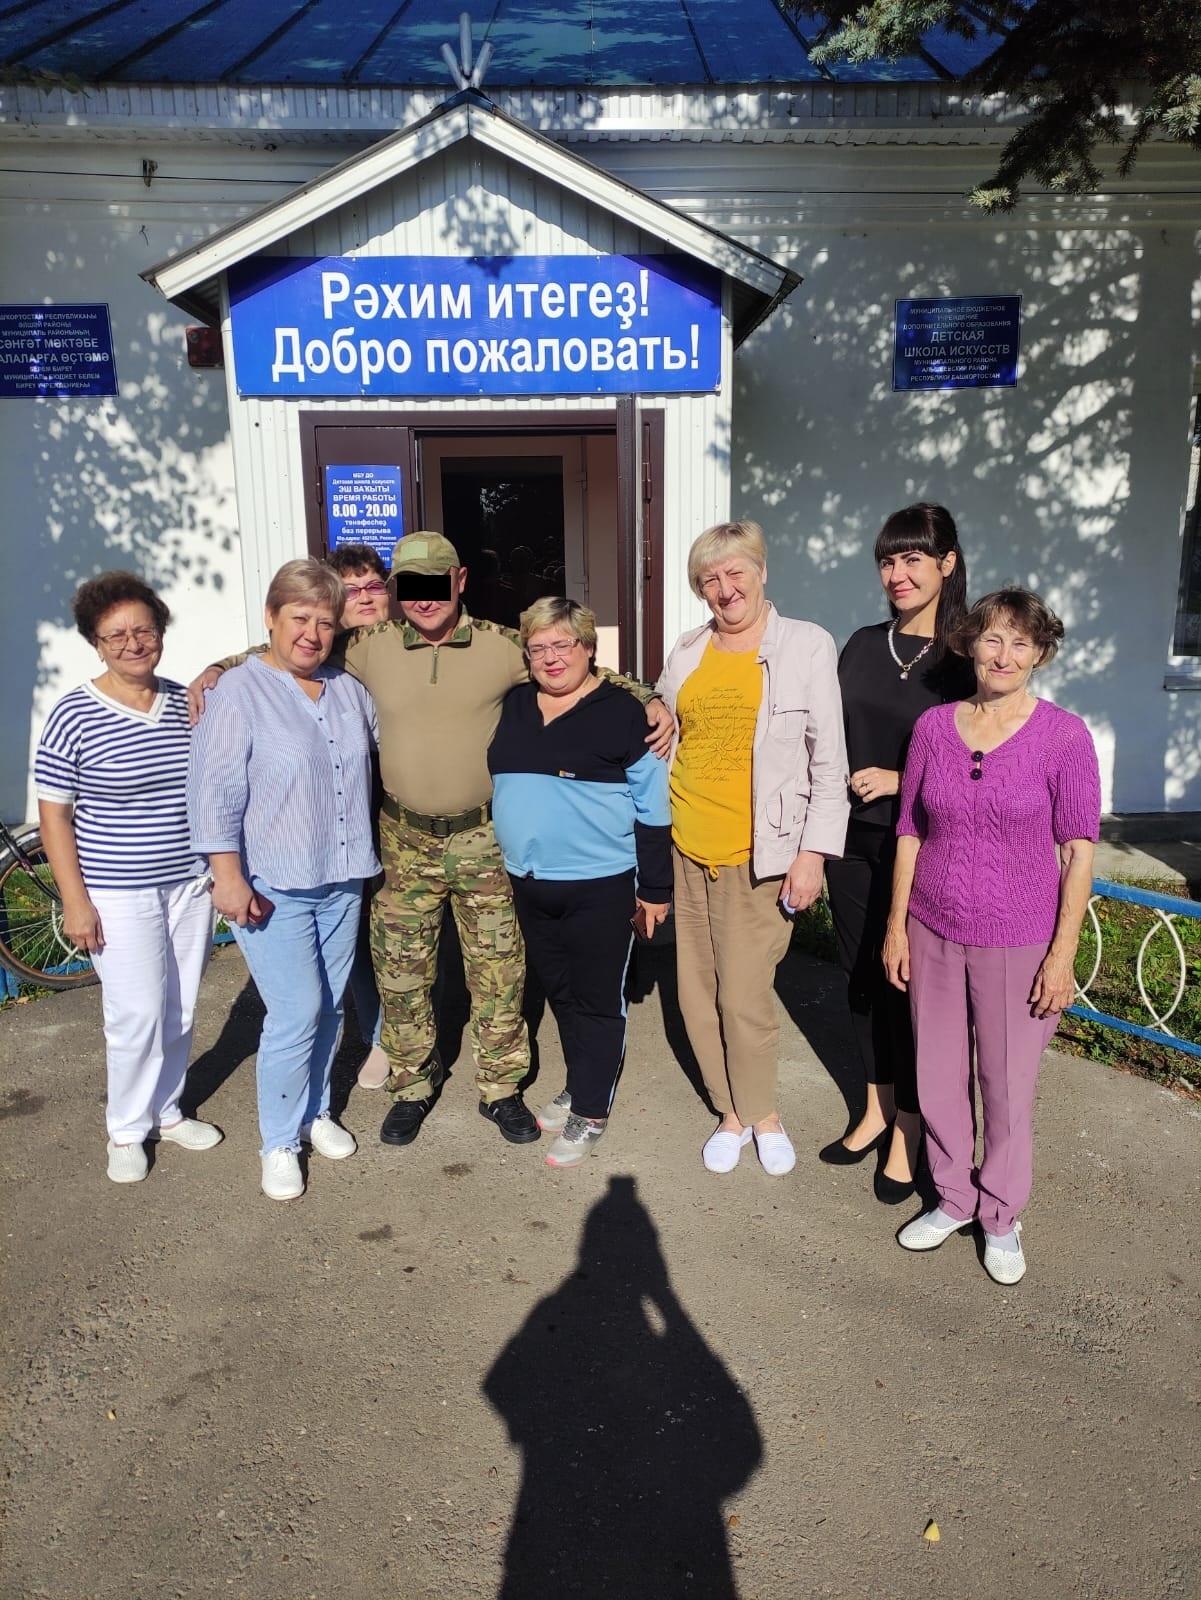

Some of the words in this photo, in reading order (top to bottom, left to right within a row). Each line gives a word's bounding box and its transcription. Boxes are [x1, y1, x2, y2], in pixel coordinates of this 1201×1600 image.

[321, 271, 473, 320] Рәхим
[488, 269, 650, 330] итегеҙ!
[930, 330, 985, 344] ДЕТСКАЯ
[271, 327, 412, 386] Добро
[426, 323, 700, 374] пожаловать!
[904, 345, 947, 357] ШКОЛА
[949, 344, 1011, 356] ИСКУССТВ
[338, 485, 352, 493] ЭШ
[333, 494, 361, 502] ВРЕМЯ
[362, 494, 396, 502] РАБОТЫ
[332, 503, 357, 517] 8.00
[365, 503, 397, 517] 20.00
